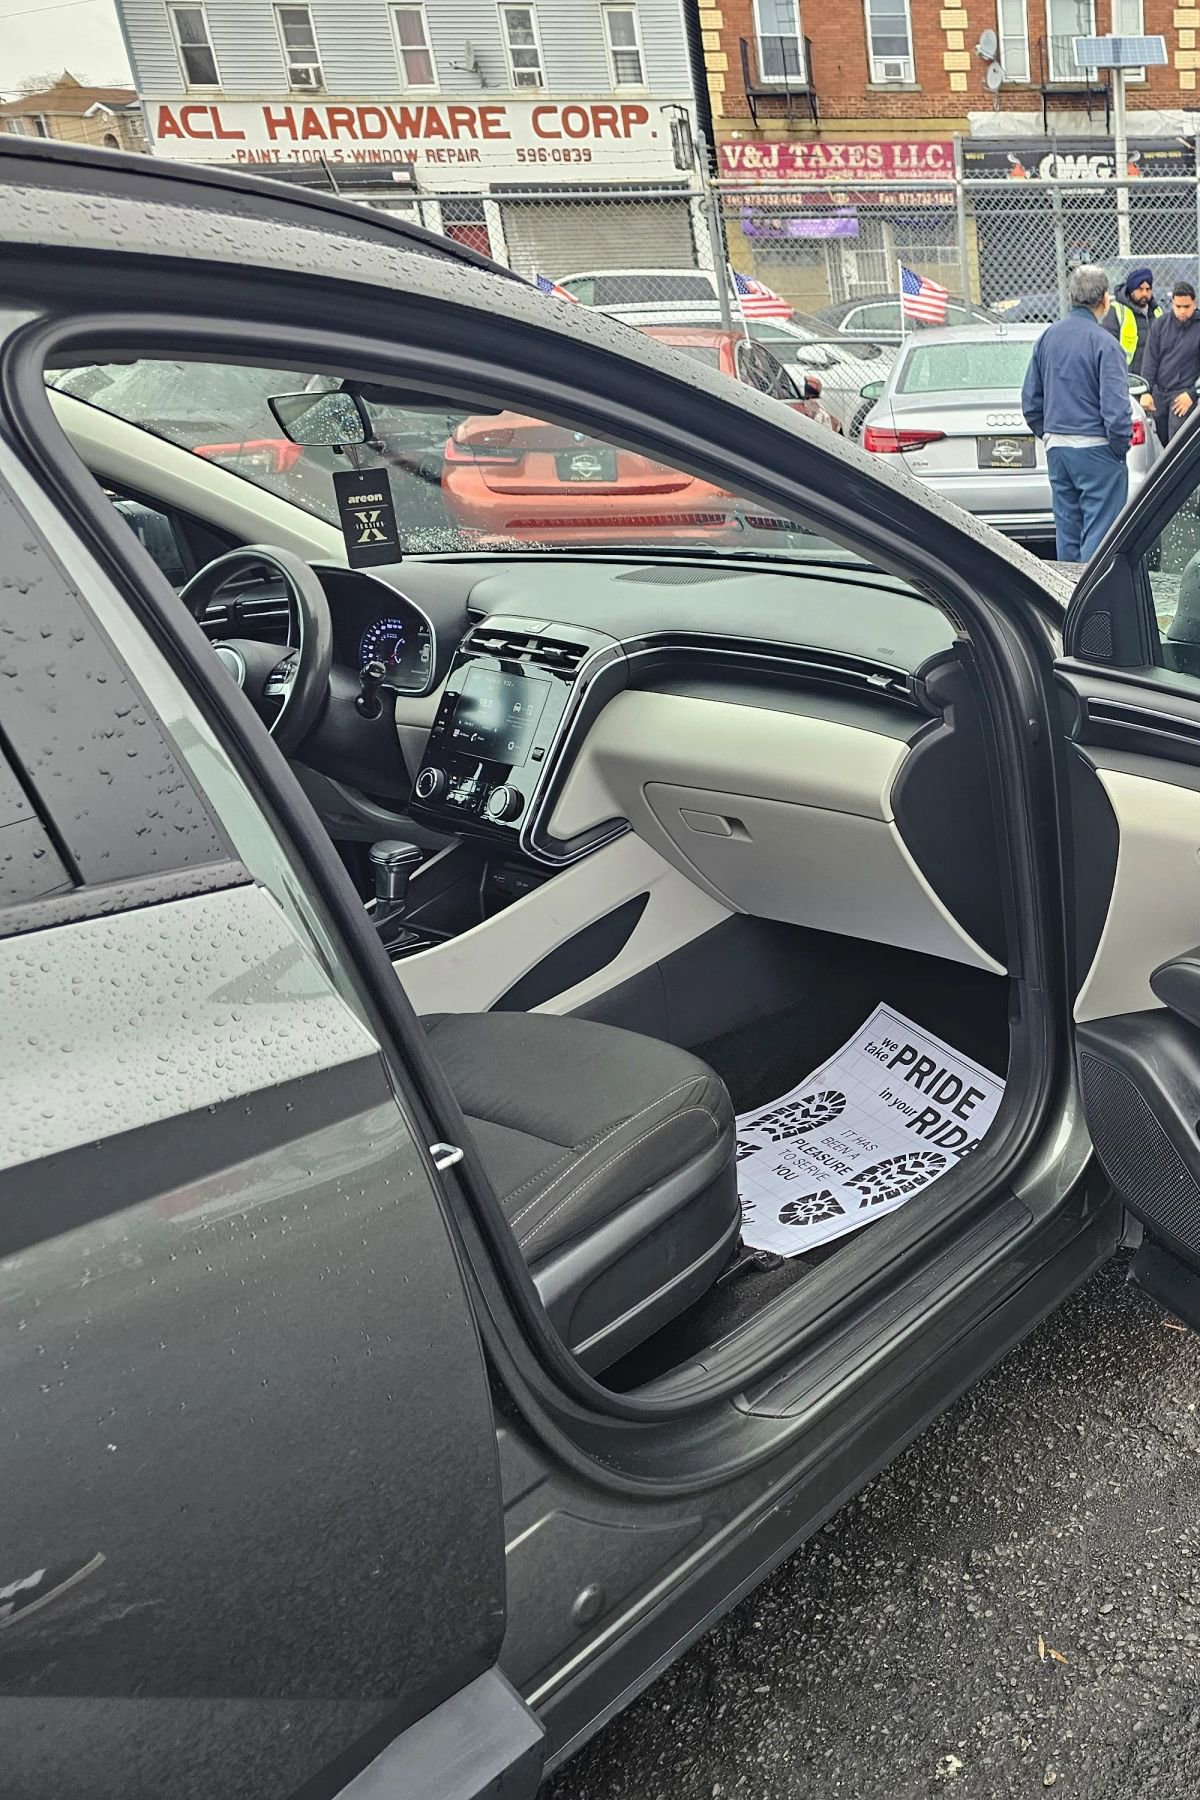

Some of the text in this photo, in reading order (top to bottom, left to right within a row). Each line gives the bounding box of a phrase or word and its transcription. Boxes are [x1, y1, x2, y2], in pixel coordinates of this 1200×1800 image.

[157, 104, 658, 140] ACL HARDWARE CORP.
[425, 148, 482, 163] REPAIR
[722, 144, 952, 169] V&J TAXES LLC.
[348, 493, 383, 504] areon
[863, 1037, 986, 1121] we take PRIDE
[878, 1087, 893, 1101] in
[888, 1101, 918, 1117] your
[820, 1136, 860, 1160] BEEN A
[840, 1129, 878, 1152] IT HAS
[778, 1148, 831, 1182] TO SERVE
[790, 1138, 854, 1176] PLEASURE
[771, 1164, 800, 1181] YOU
